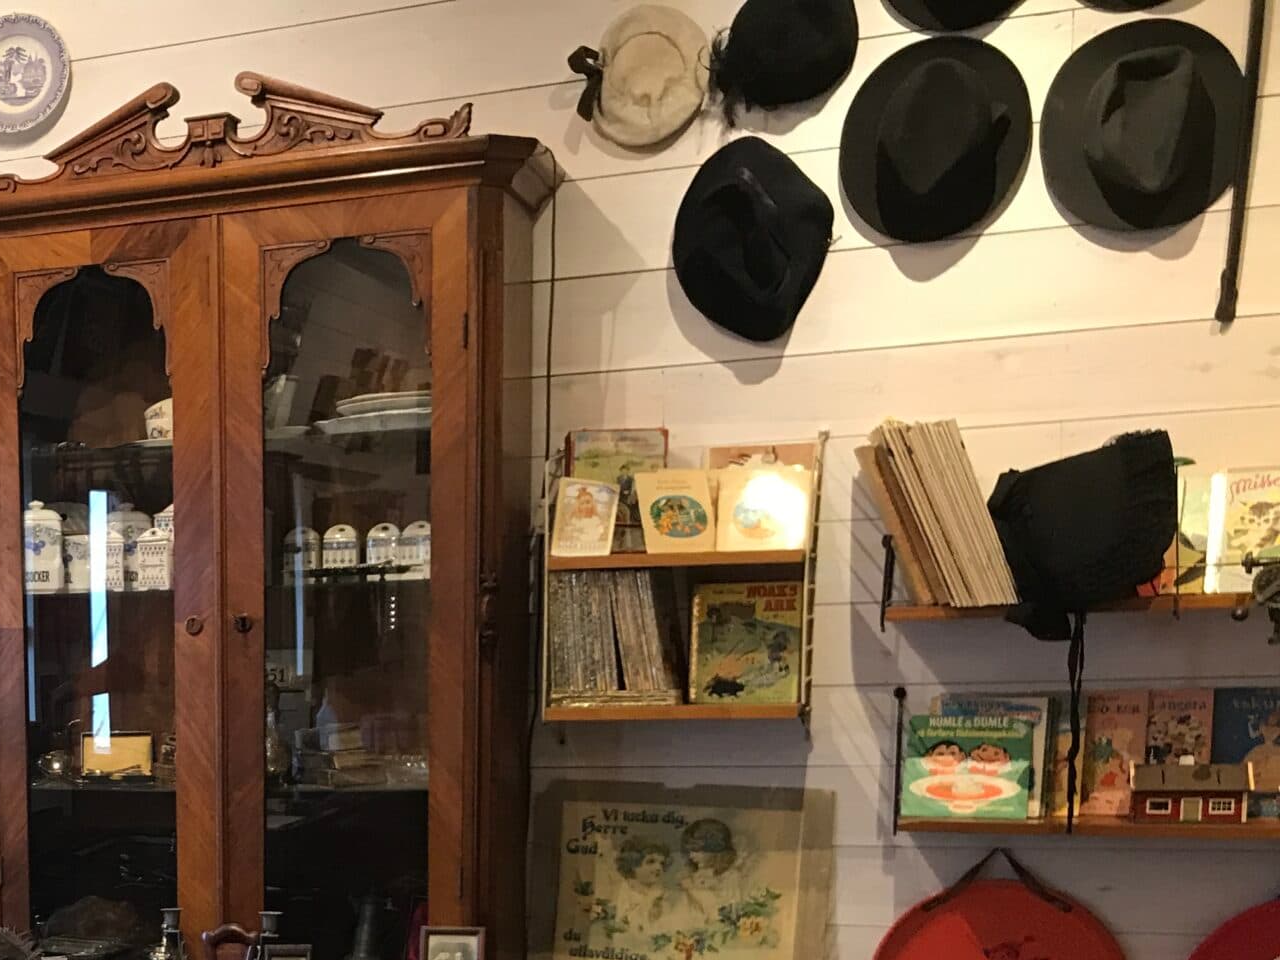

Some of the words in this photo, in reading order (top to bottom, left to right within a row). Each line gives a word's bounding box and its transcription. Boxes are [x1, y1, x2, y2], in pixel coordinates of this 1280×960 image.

[762, 598, 797, 612] ARK
[602, 809, 619, 822] Vi
[563, 928, 581, 942] du
